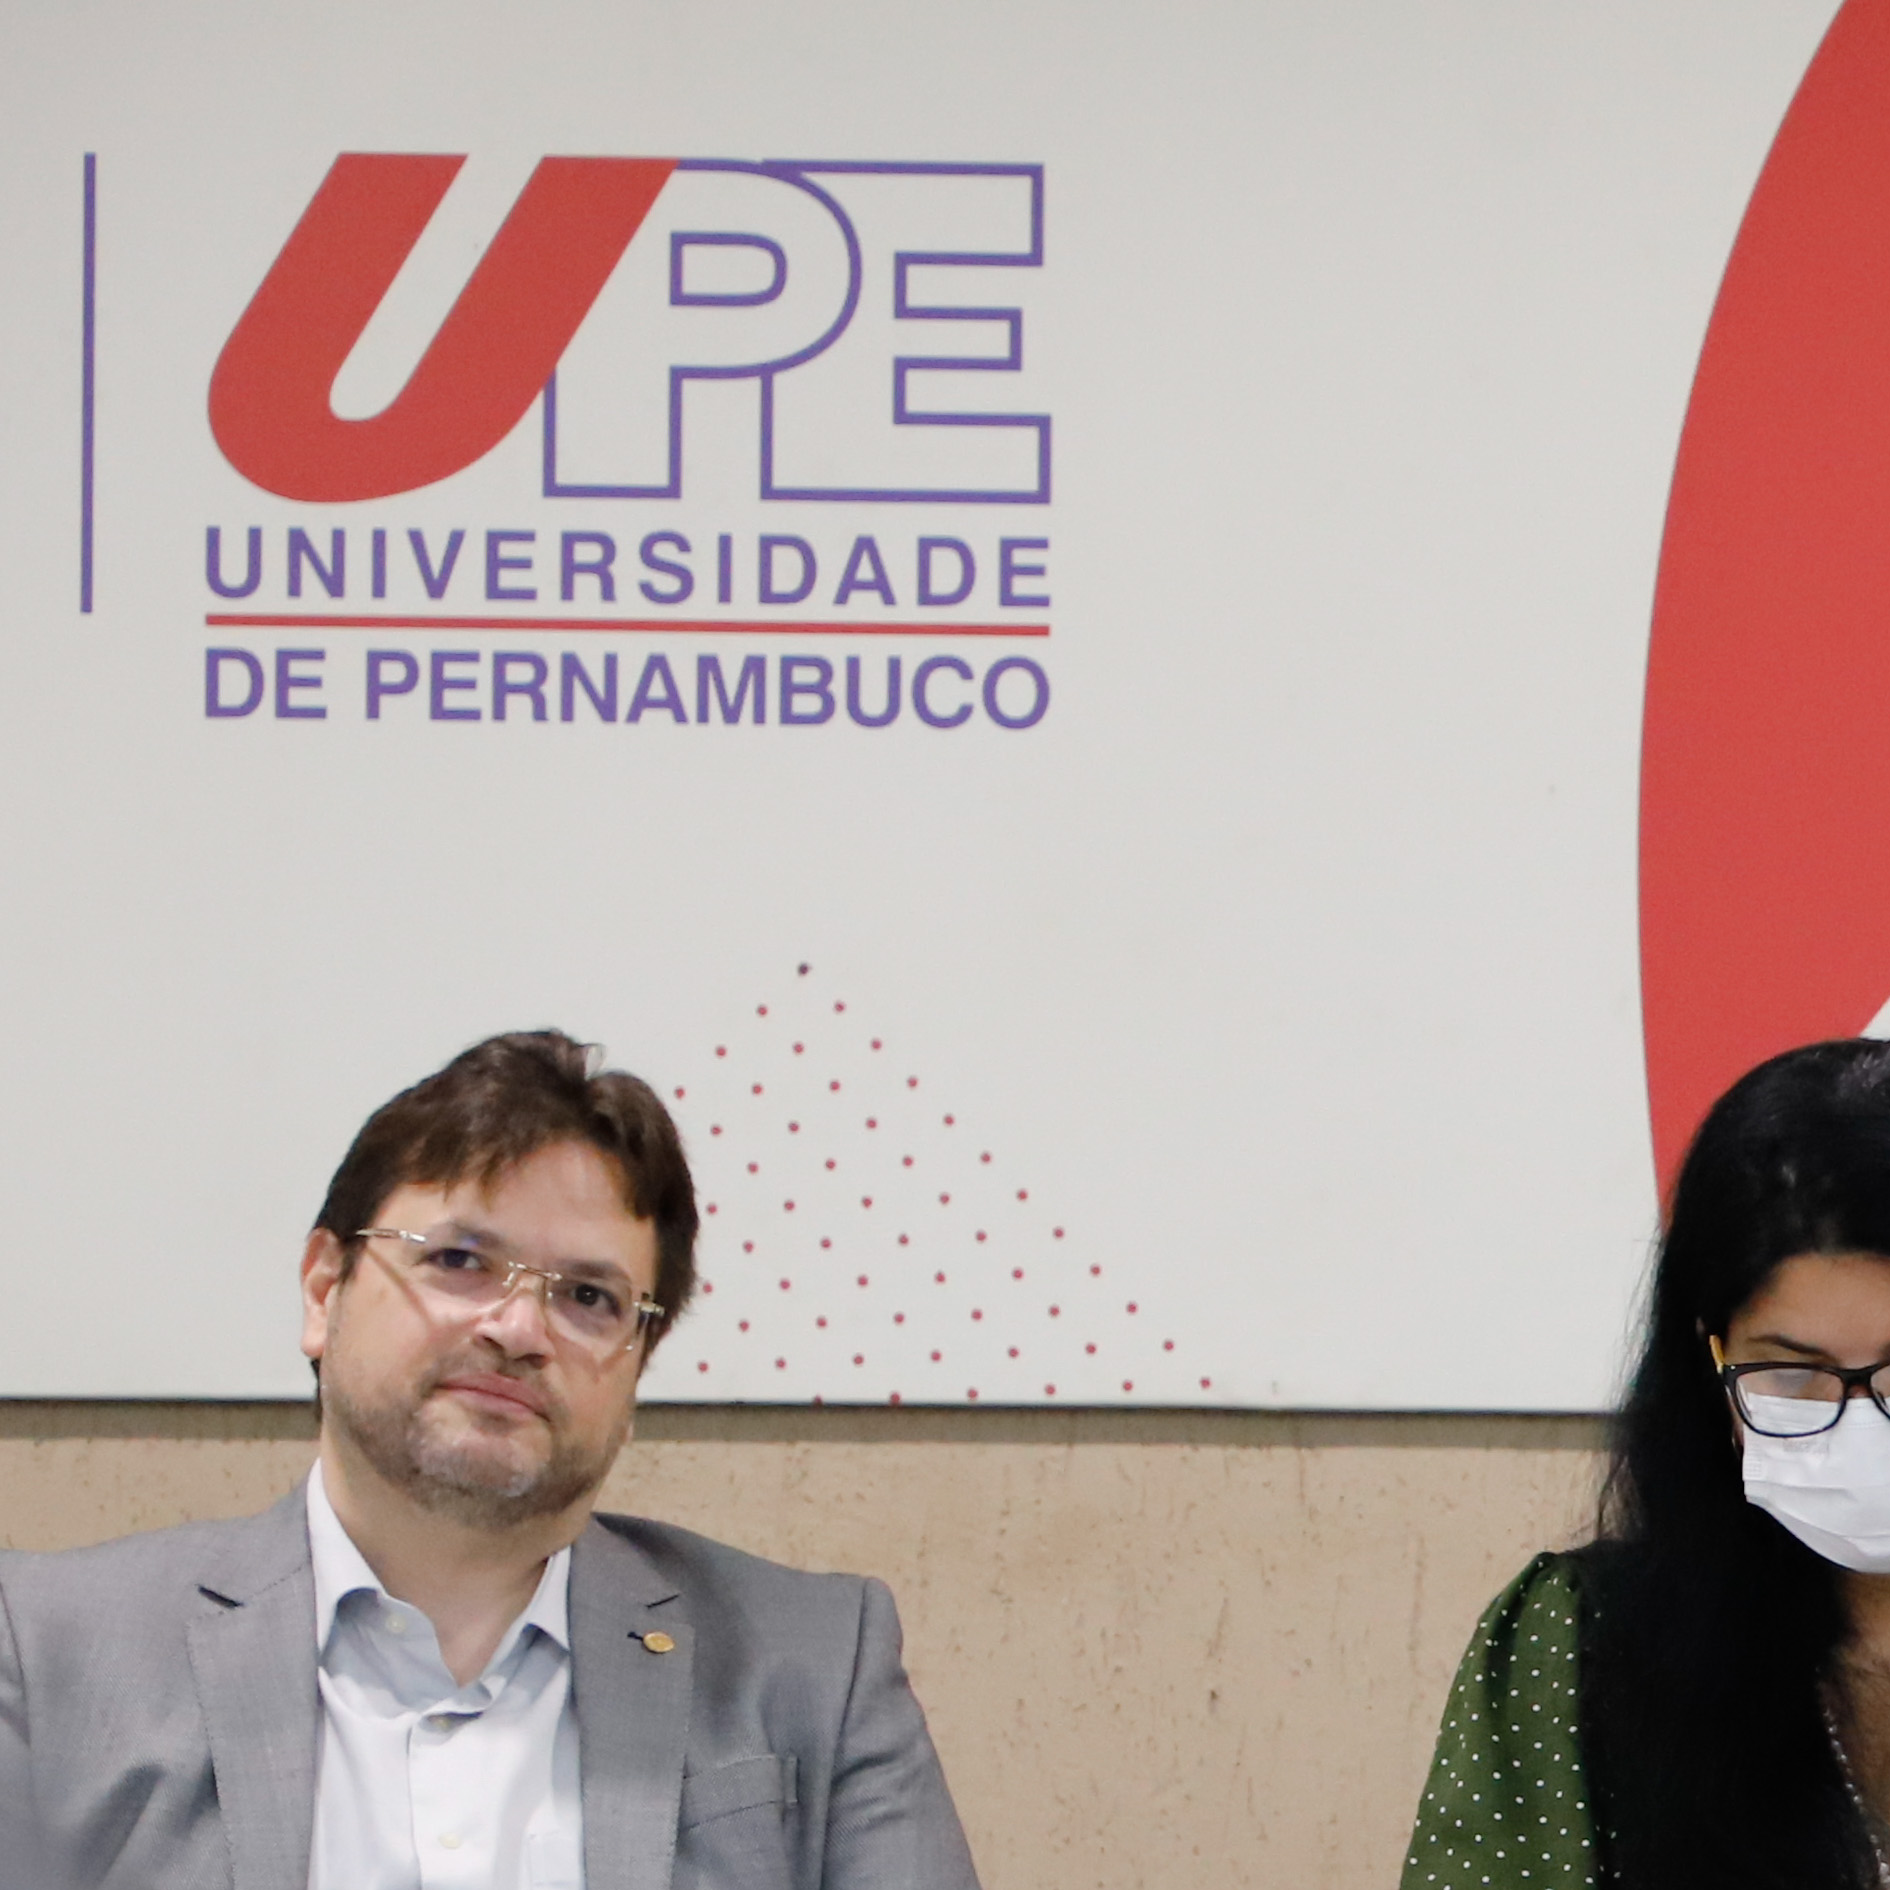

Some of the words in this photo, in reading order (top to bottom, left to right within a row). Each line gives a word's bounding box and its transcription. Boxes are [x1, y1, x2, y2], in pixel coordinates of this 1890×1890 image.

[207, 152, 1051, 504] UPE
[206, 526, 1051, 608] UNIVERSIDADE
[206, 648, 327, 720] DE
[366, 651, 1051, 729] PERNAMBUCO
